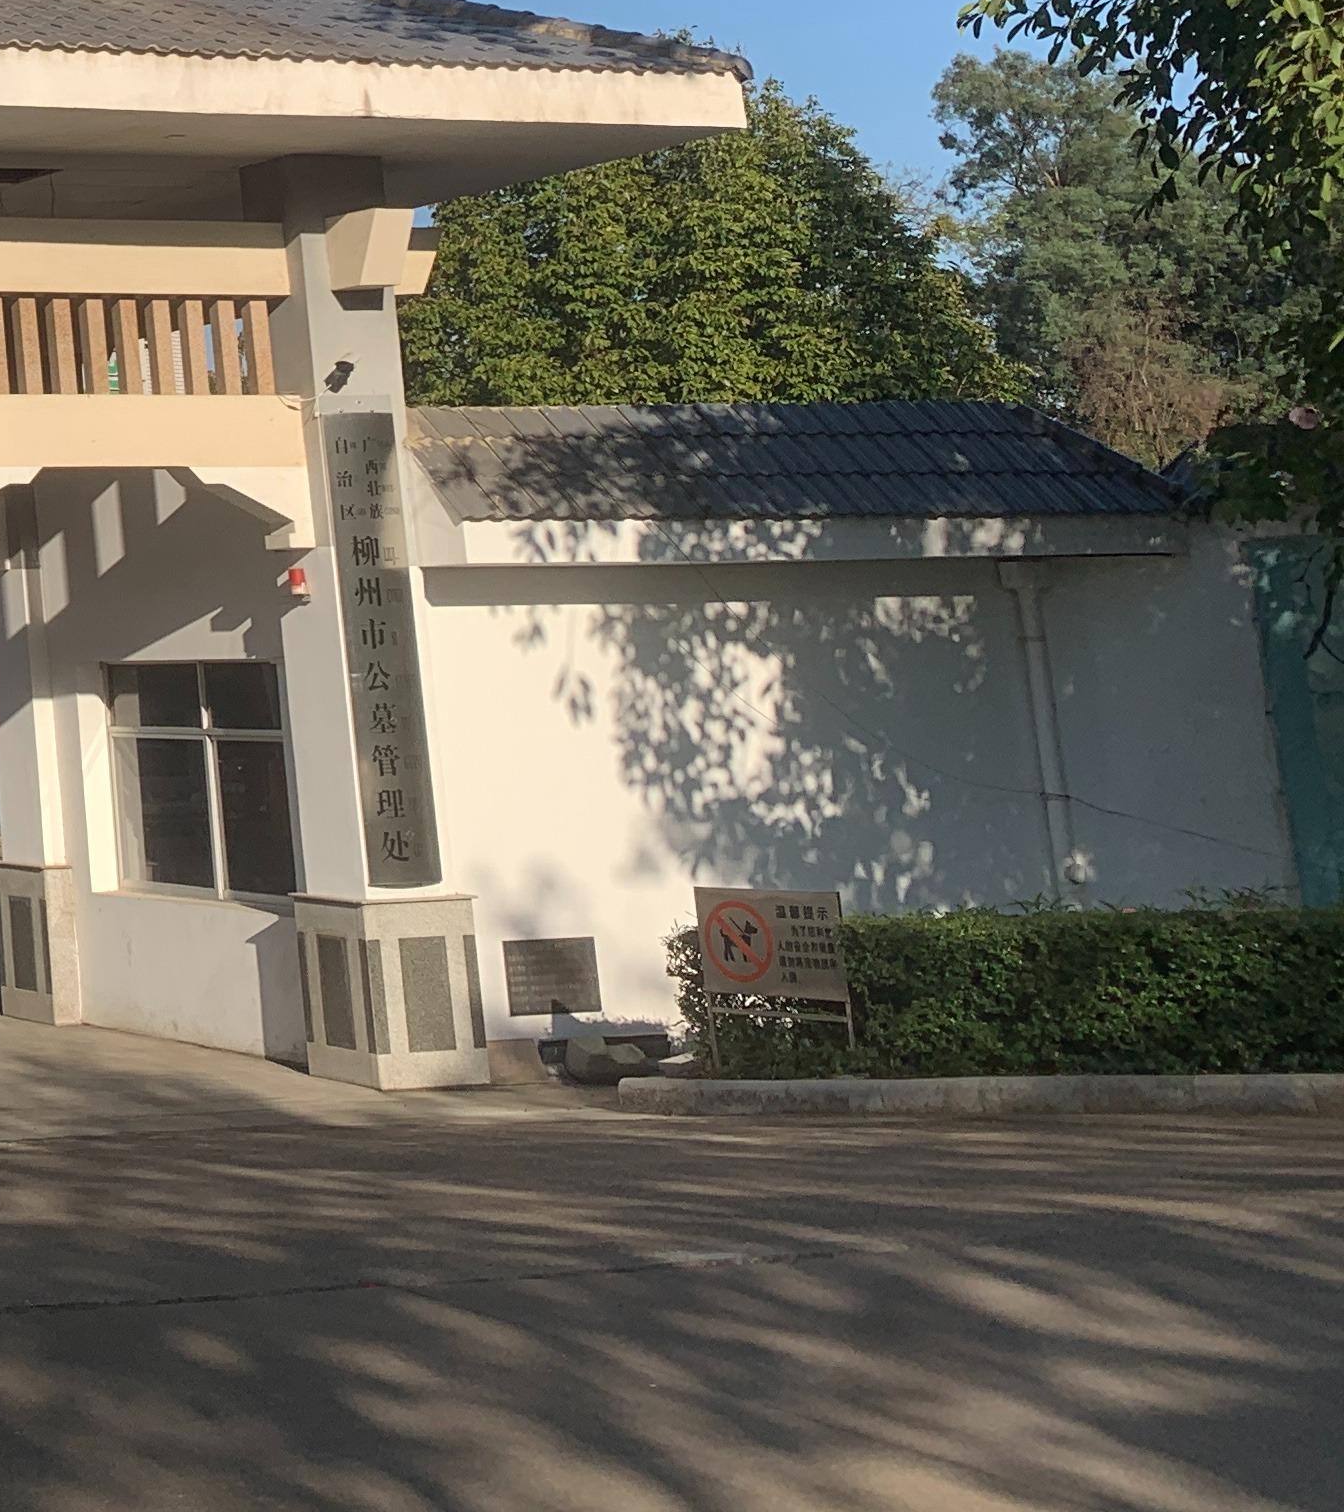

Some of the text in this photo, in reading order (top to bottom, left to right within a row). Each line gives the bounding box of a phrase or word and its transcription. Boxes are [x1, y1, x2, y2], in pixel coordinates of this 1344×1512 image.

[335, 436, 357, 521] 自治区
[362, 435, 384, 520] 广西壮族
[351, 535, 410, 863] 柳州市公墓管理处
